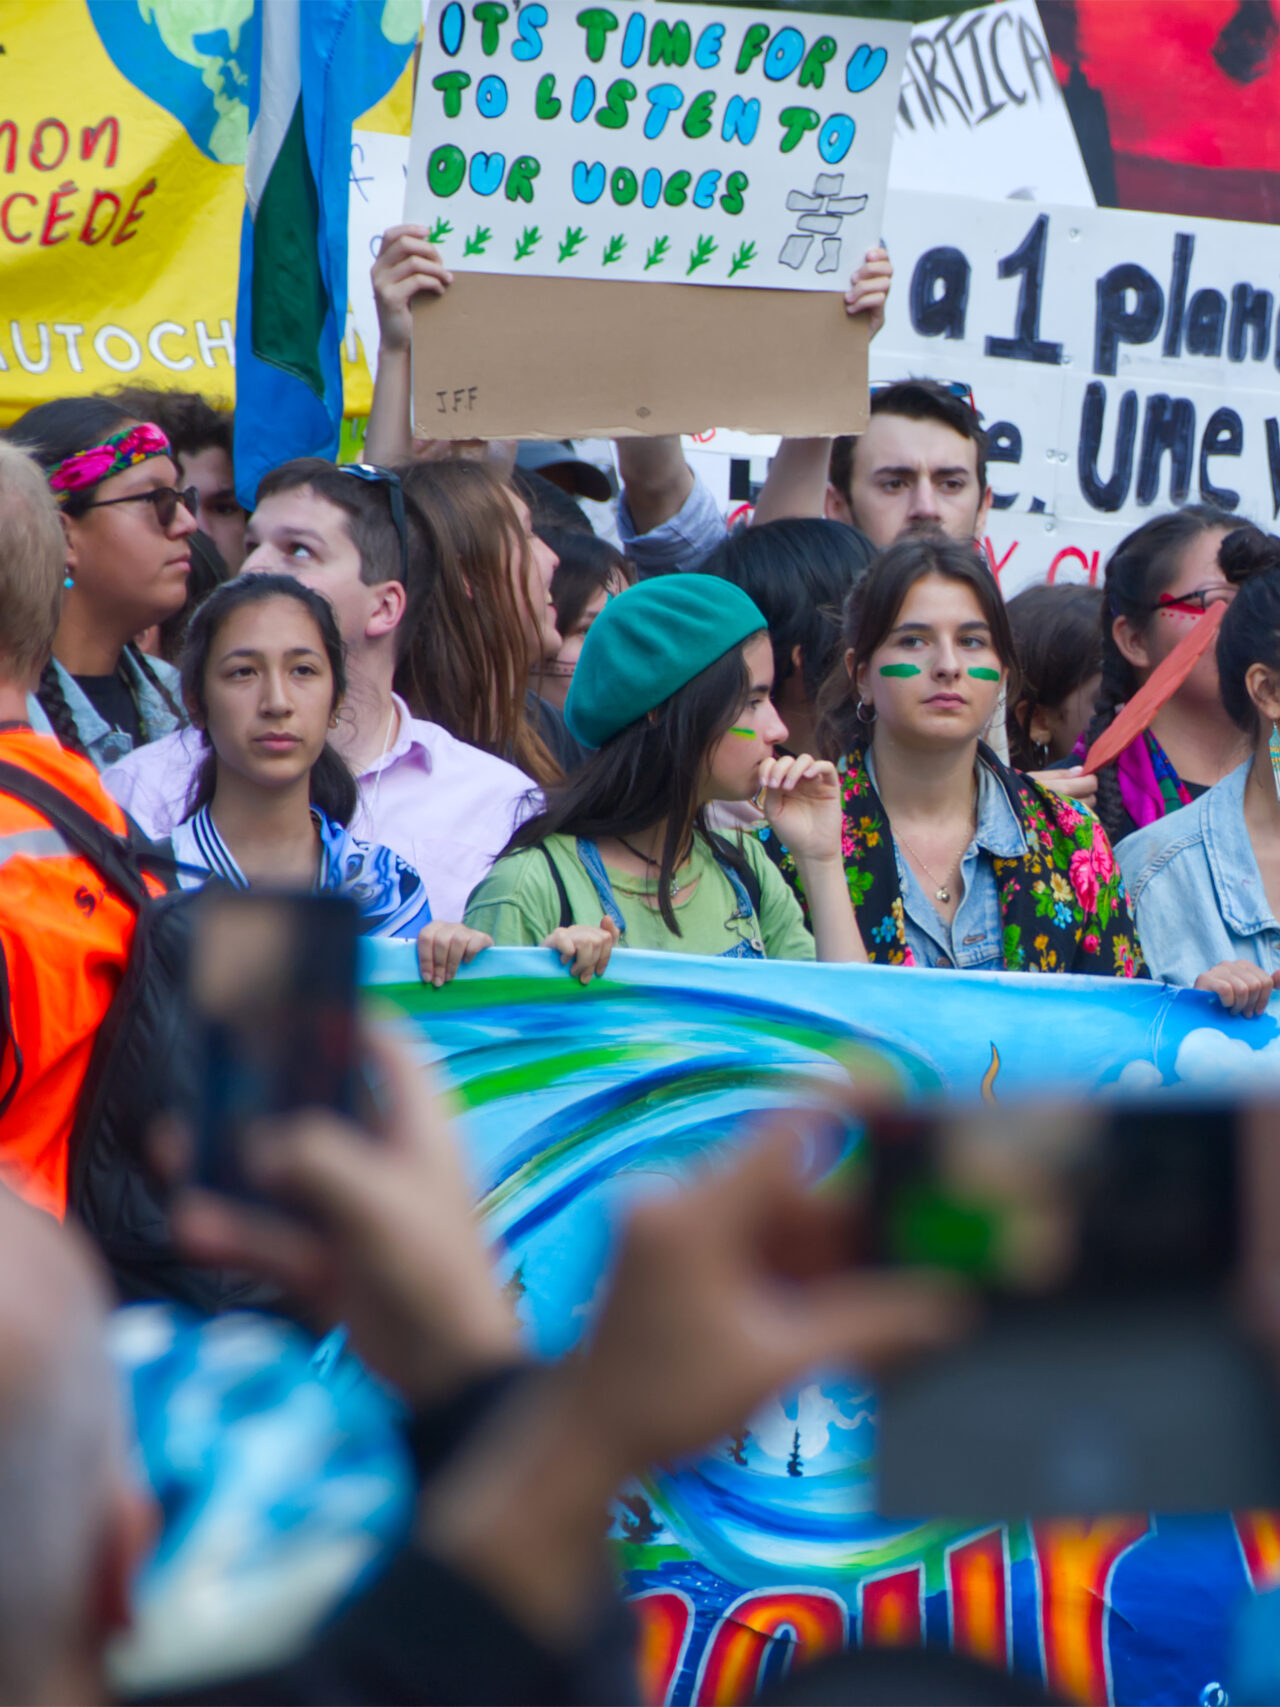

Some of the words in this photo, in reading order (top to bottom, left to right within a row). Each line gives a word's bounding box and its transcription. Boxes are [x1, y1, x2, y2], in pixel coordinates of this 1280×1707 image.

[439, 0, 549, 61] IT'S
[576, 7, 726, 69] TIME
[735, 23, 838, 89] FOR
[845, 44, 888, 93] U
[432, 70, 509, 119] TO
[535, 73, 761, 146] LISTEN
[778, 105, 856, 165] TO
[427, 143, 541, 203] OUR
[908, 246, 971, 340] a
[984, 212, 1064, 366] 1
[0, 318, 236, 374] UTOCH
[1078, 381, 1244, 513] Une
